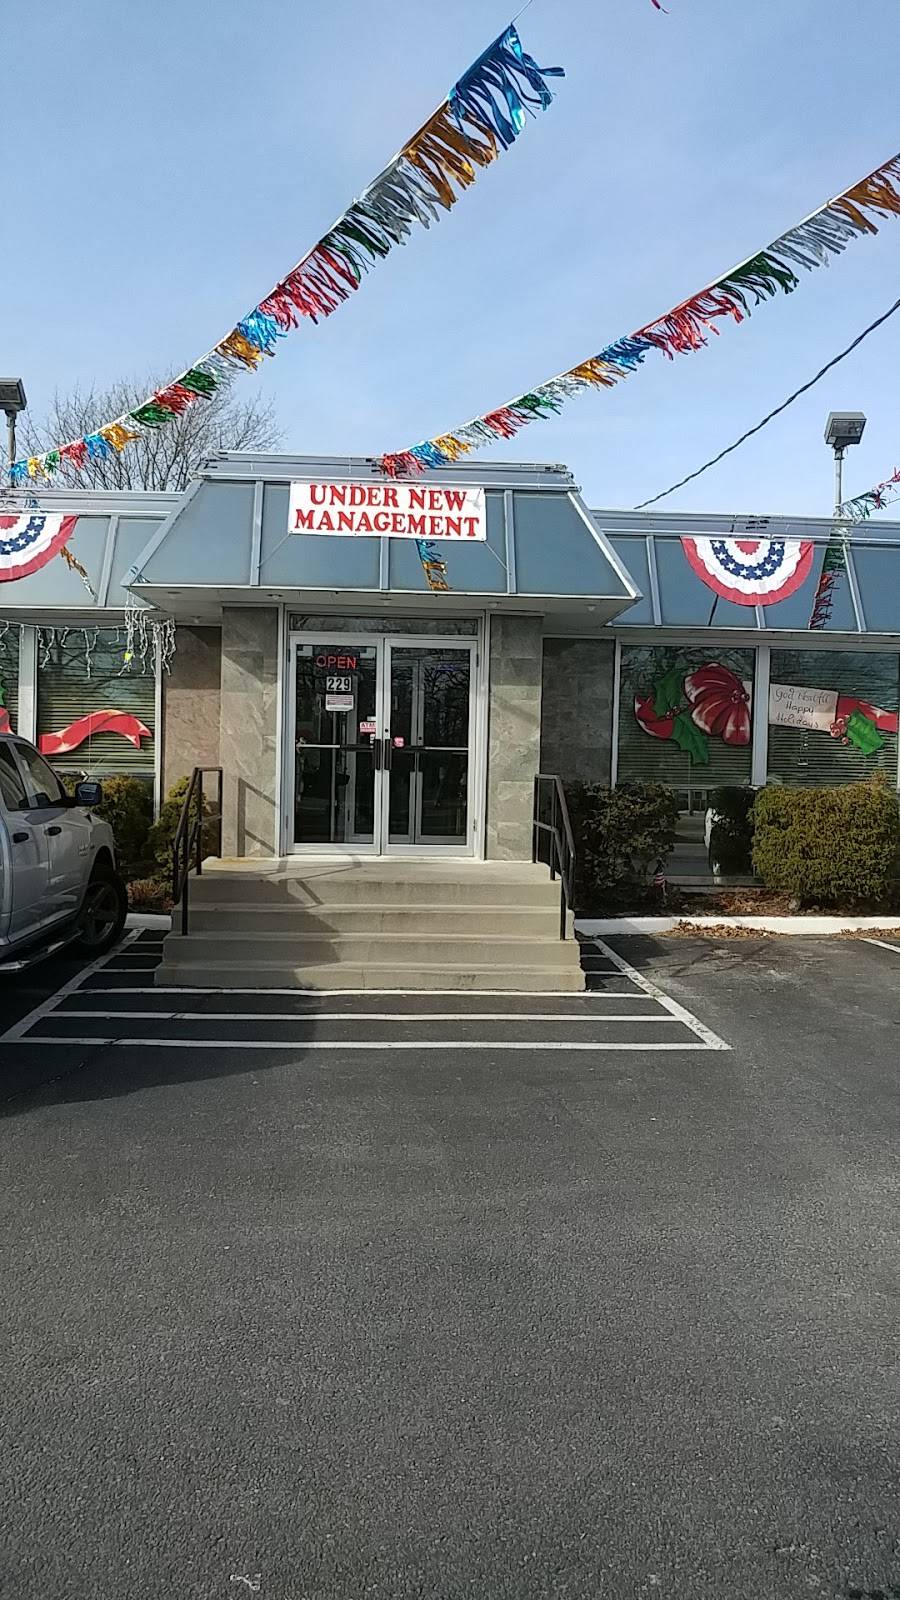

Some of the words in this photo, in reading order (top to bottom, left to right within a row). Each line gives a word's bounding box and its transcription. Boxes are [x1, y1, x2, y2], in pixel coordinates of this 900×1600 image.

[309, 485, 399, 508] UNDER
[408, 489, 467, 511] NEW
[294, 509, 480, 537] MANAGEMENT
[316, 655, 357, 669] OPEN
[327, 678, 350, 691] 229
[785, 701, 814, 716] Happy
